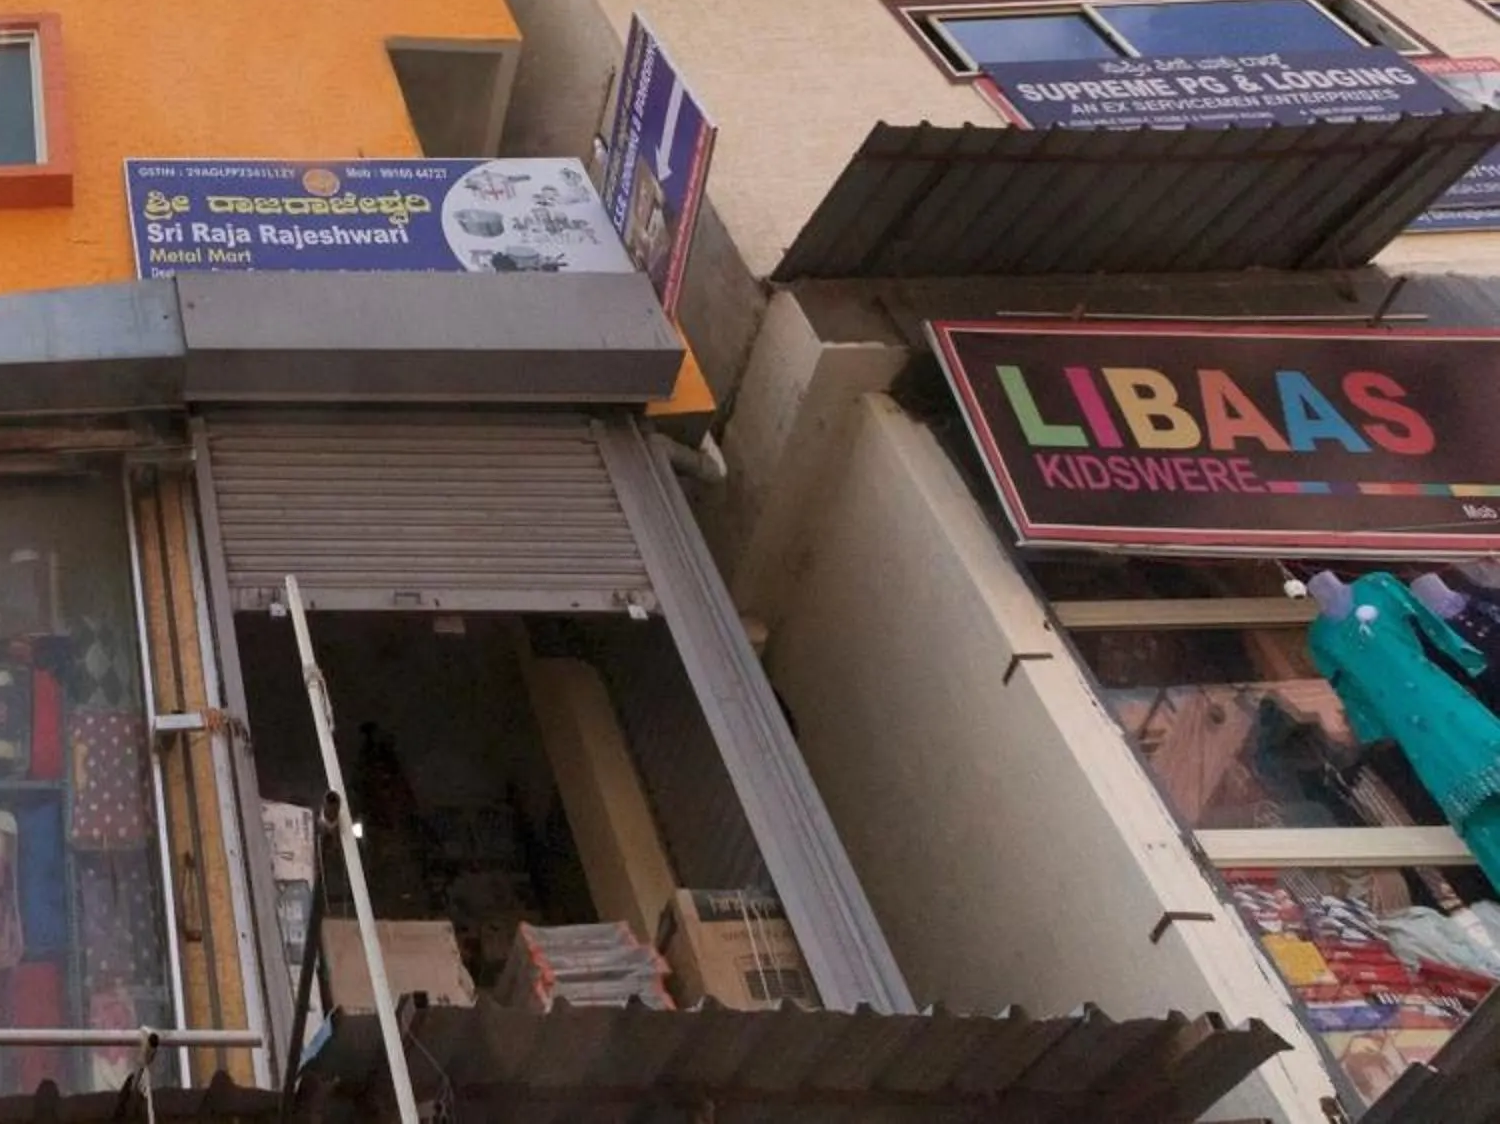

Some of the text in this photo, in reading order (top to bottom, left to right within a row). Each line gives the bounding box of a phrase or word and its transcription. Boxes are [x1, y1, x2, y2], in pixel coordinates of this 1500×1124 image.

[1015, 67, 1417, 102] SUPREME PG & LODGING
[1071, 88, 1400, 115] AN EX SERVICEMEN ENTERPRISES
[138, 167, 175, 176] GSTIN
[143, 189, 432, 228] ಶ್ರೀ ರಾಜರಾಜೇಶ್ವರಿ
[147, 221, 410, 250] Sri Raja Rajeshwari
[150, 248, 252, 263] Metal Mart
[996, 365, 1435, 456] LIBAAS
[1034, 453, 1269, 493] KIDSWERE
